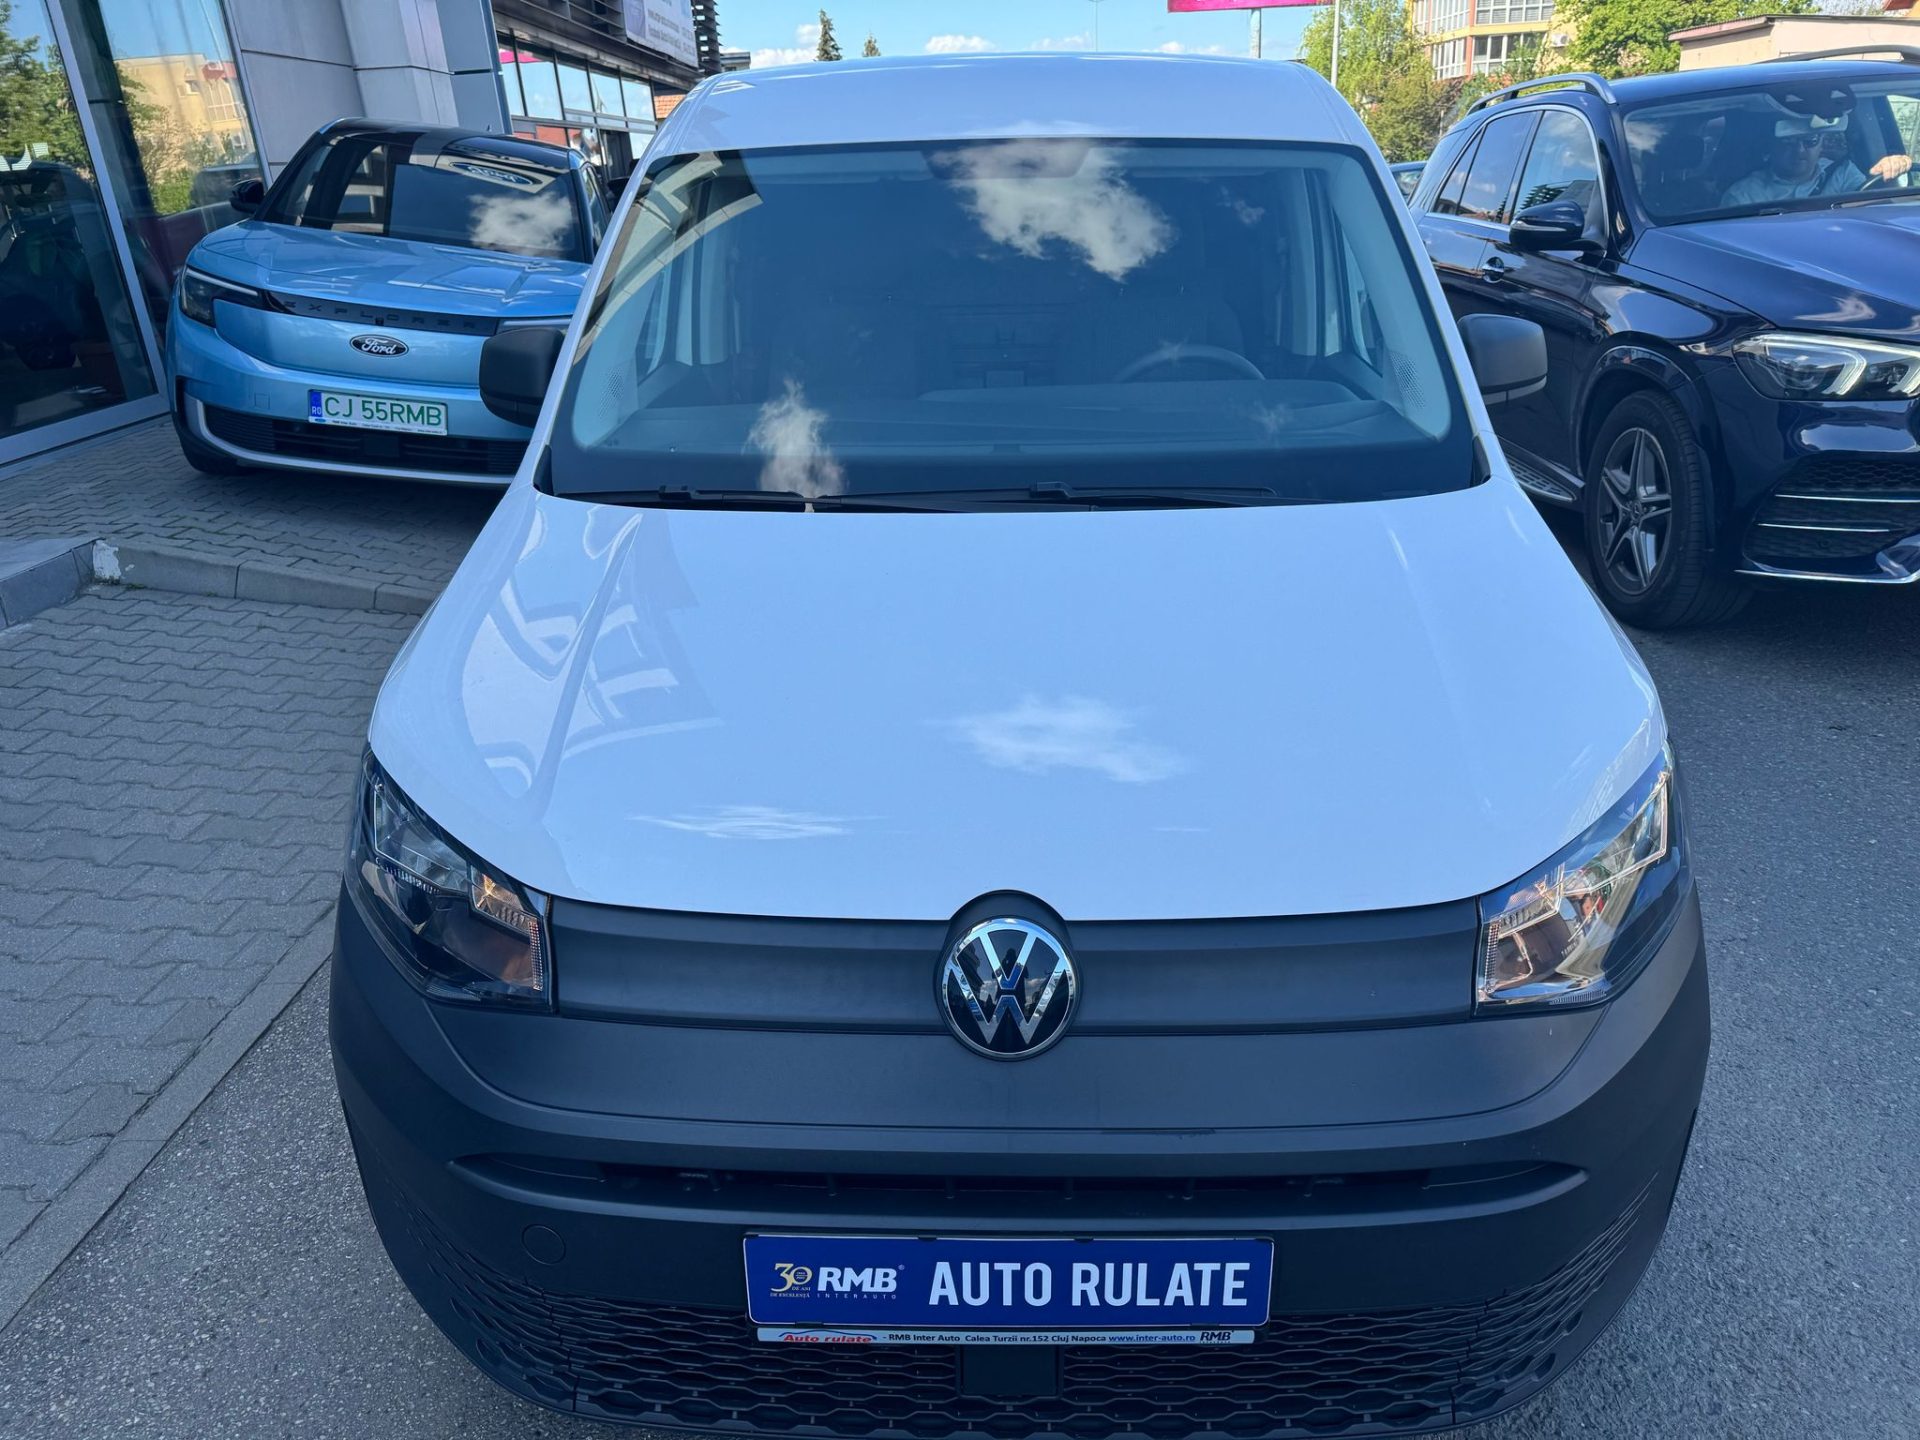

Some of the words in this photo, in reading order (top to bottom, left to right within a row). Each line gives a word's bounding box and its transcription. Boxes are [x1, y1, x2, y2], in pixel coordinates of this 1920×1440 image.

[361, 338, 397, 355] Ford
[311, 406, 322, 415] RO
[324, 397, 353, 418] CJ
[770, 1262, 813, 1292] 30
[817, 1266, 898, 1293] RMB
[928, 1262, 1053, 1306] AUTO
[1071, 1262, 1251, 1306] RULATE
[783, 1334, 820, 1343] Auto
[824, 1334, 872, 1343] rulate
[888, 1333, 911, 1341] RMB
[913, 1334, 936, 1342] Inter
[937, 1334, 960, 1342] Auto
[1051, 1335, 1069, 1343] Cluj
[1108, 1333, 1196, 1342] www.inter-auto.ro
[1200, 1331, 1231, 1341] RMB
